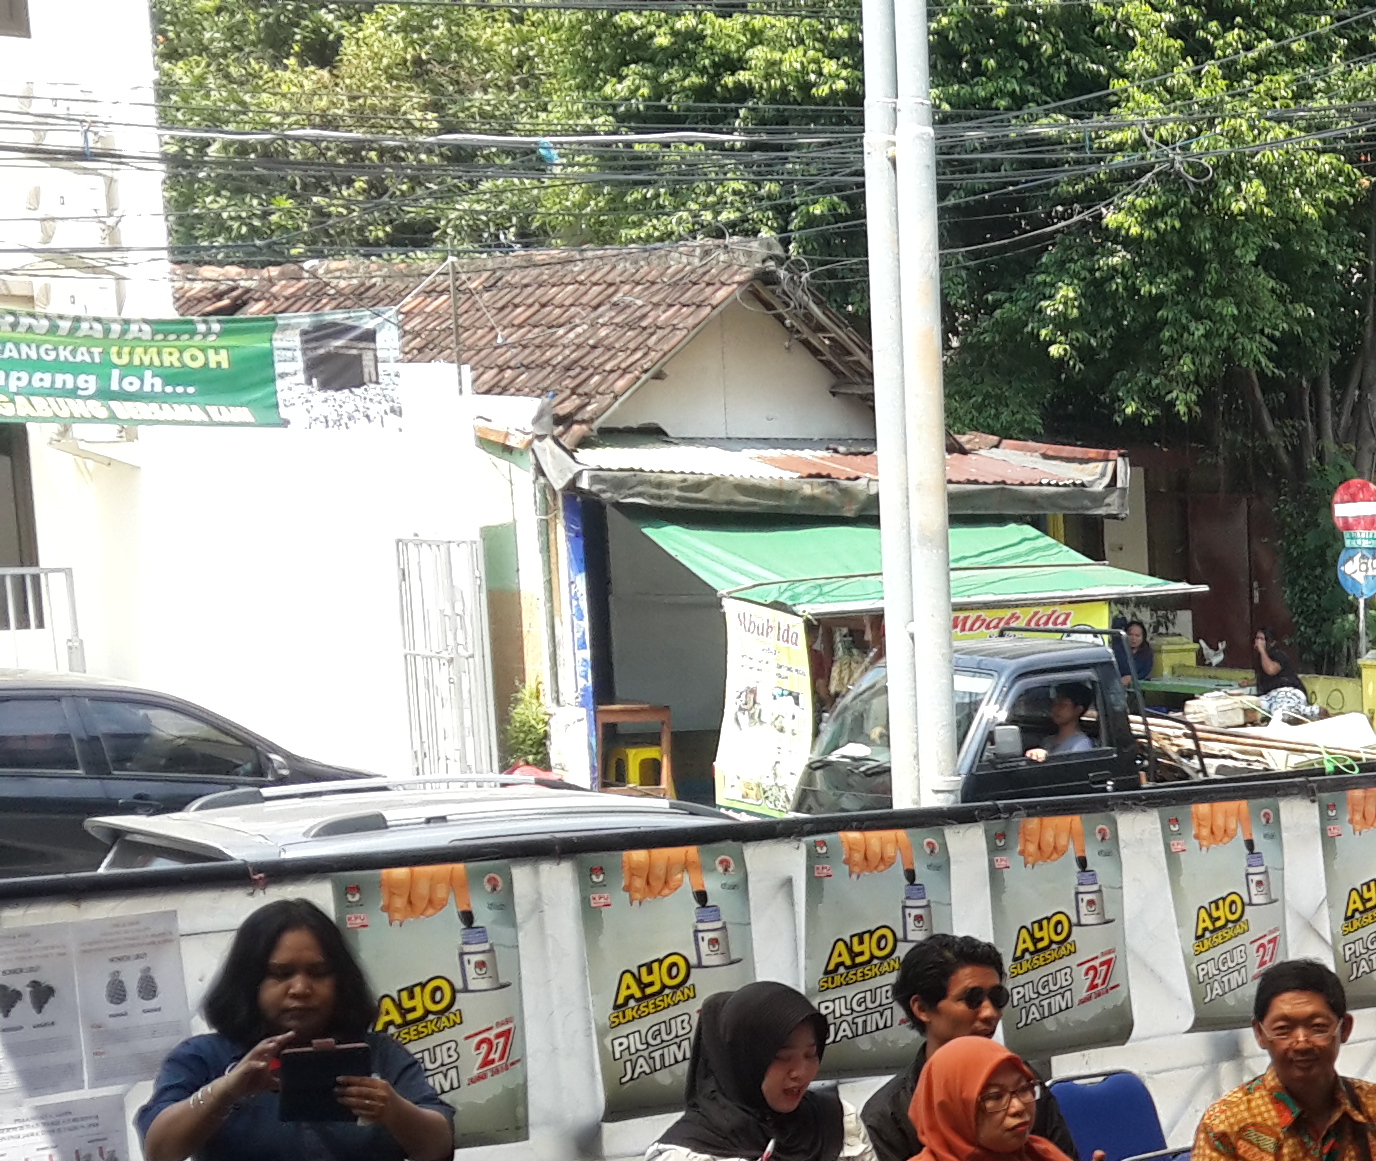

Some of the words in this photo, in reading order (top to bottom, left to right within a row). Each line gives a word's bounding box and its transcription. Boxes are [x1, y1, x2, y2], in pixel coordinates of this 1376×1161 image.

[0, 342, 104, 363] ANGKAT
[110, 346, 230, 369] UMROH
[110, 369, 195, 394] loh...
[1025, 608, 1073, 627] Ida
[1195, 891, 1245, 940] AYO
[824, 925, 897, 974] AYO
[1013, 911, 1072, 961] AYO
[1255, 935, 1280, 970] 27
[613, 952, 690, 1007] AYO
[818, 957, 900, 992] SUKSESKAN
[1009, 941, 1076, 978] SUKSESKAN
[1083, 956, 1115, 993] 27
[1196, 944, 1247, 984] PILGUB
[375, 976, 455, 1032] AYO
[1011, 967, 1073, 1008] PILGUB
[1204, 966, 1248, 1004] JATIM
[609, 984, 696, 1028] SUKSESKAN
[1016, 989, 1074, 1029] JATIM
[394, 1010, 462, 1044] SESKAN
[612, 1013, 692, 1060] PILGUB
[475, 1027, 515, 1071] 27
[620, 1039, 690, 1084] JATIM
